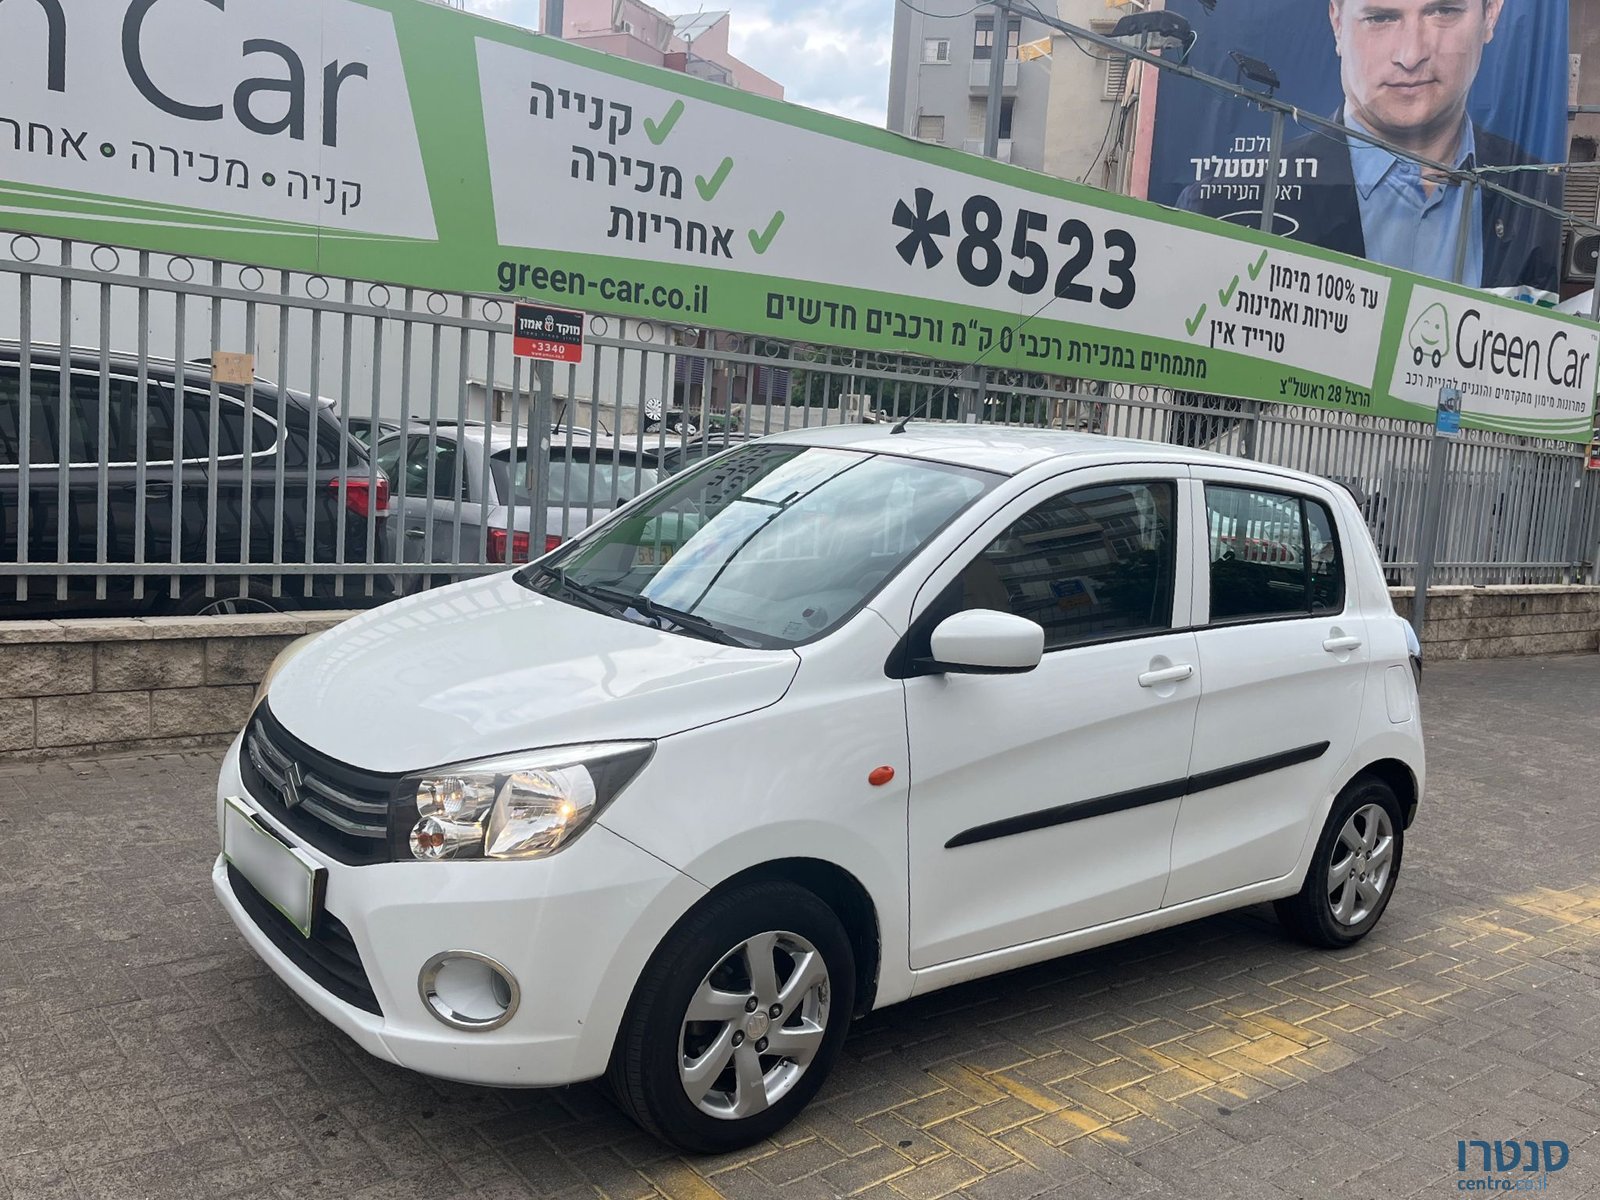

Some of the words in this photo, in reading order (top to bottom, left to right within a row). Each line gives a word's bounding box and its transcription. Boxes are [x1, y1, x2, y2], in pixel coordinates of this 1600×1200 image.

[121, 0, 369, 148] Car
[529, 81, 633, 145] קנייה
[131, 140, 249, 189] מכירה
[571, 145, 683, 200] מכירה
[1295, 157, 1318, 178] רז
[287, 170, 362, 215] קניה
[1200, 184, 1260, 201] העירייה
[607, 205, 735, 259] אחריות
[497, 260, 708, 314] green-car.co.il
[1269, 264, 1311, 293] מימון
[1316, 273, 1356, 305] 100%
[766, 292, 857, 331] חדשים
[1236, 290, 1299, 323] ואמינות
[1360, 287, 1378, 310] עד
[520, 318, 543, 331] אמון
[556, 323, 581, 336] מוקד
[866, 308, 944, 343] ורכבים
[1210, 319, 1237, 348] אין
[1302, 305, 1348, 334] שירות
[1000, 326, 1013, 353] 0
[1019, 333, 1062, 360] רכבי
[1242, 325, 1285, 353] טרייד
[1456, 308, 1540, 381] Green
[1547, 331, 1590, 389] Car
[1067, 340, 1135, 369] במכירת
[1140, 350, 1207, 379] מתמחים
[1327, 384, 1342, 403] 28
[1405, 371, 1424, 387] רכב
[1345, 386, 1371, 408] הרצל
[1495, 387, 1532, 405] מתקדמים
[1534, 394, 1555, 408] מימון
[1556, 398, 1586, 413] פתרונות
